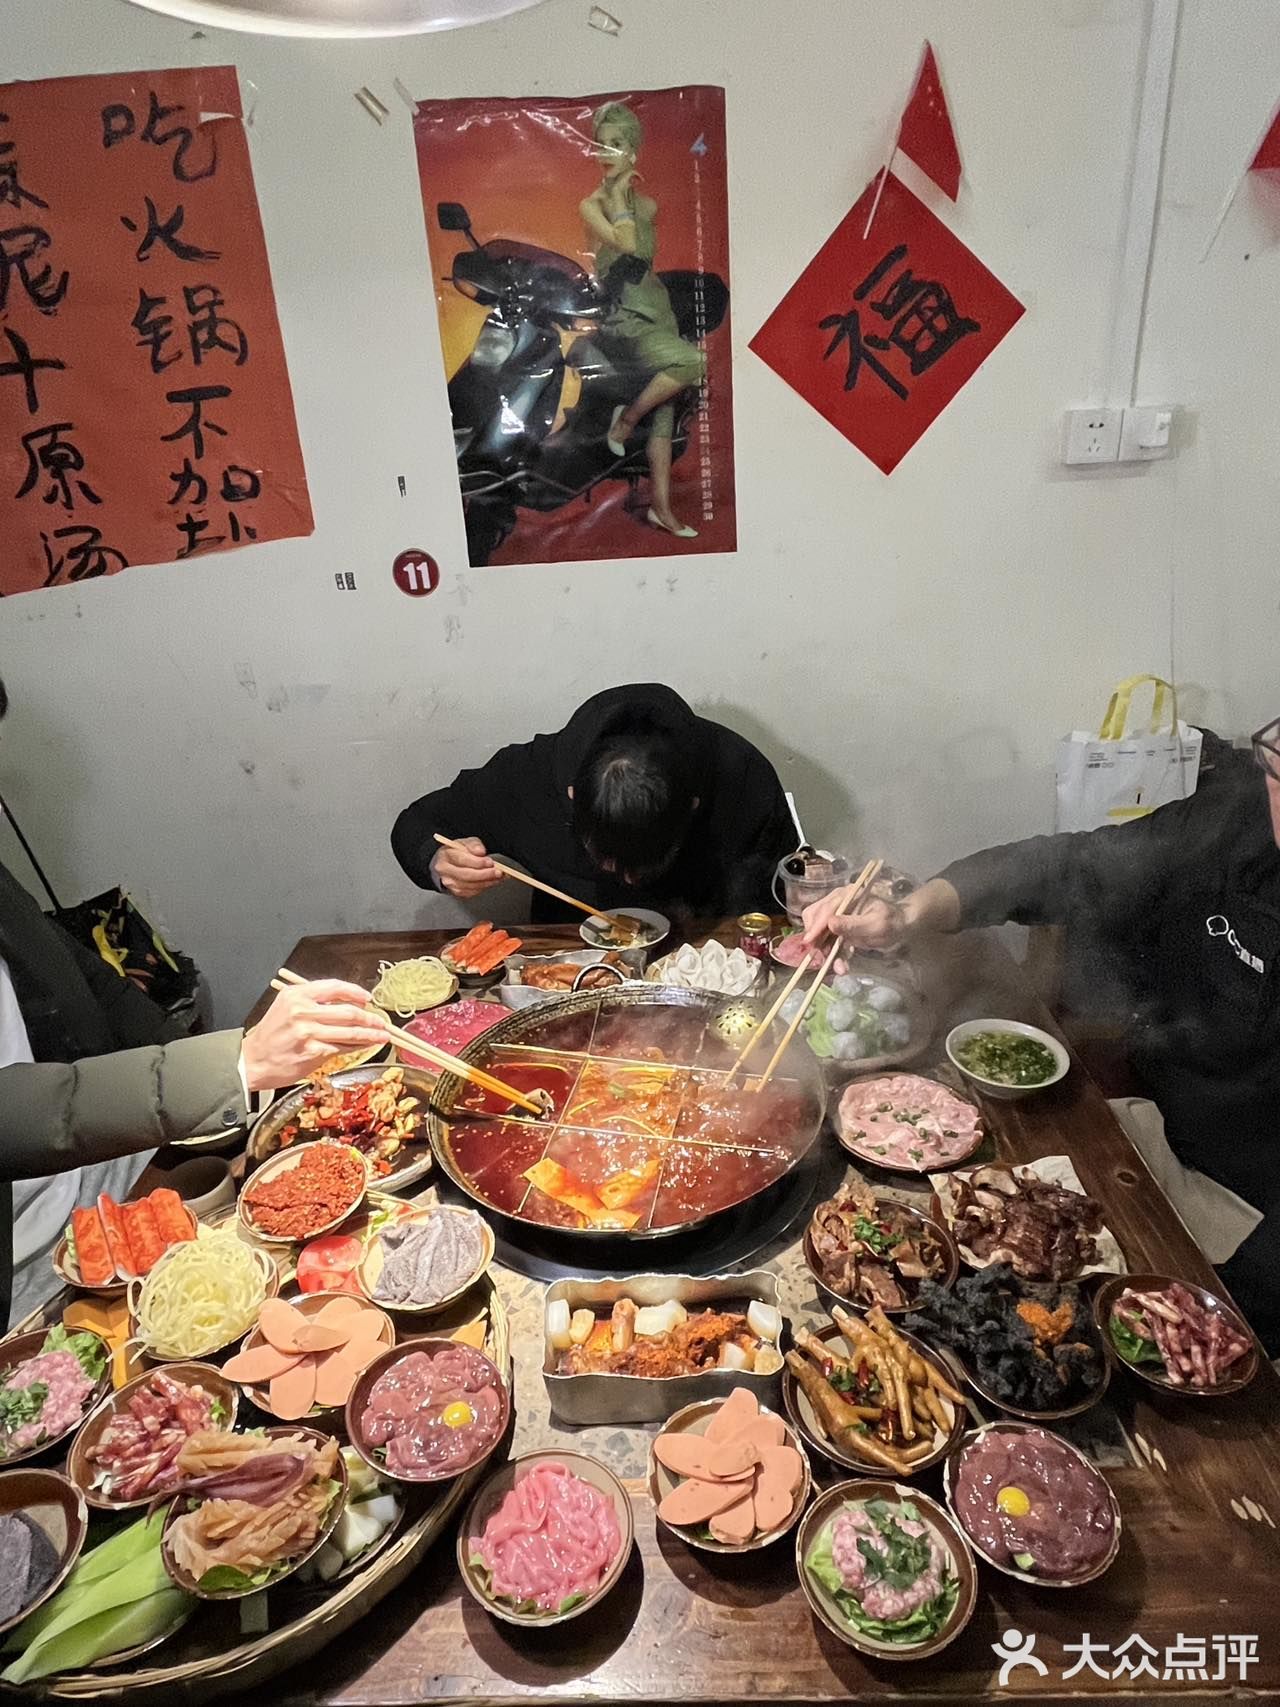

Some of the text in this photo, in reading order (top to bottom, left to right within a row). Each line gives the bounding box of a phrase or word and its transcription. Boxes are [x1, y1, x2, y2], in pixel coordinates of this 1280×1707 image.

[689, 132, 708, 156] 4
[818, 244, 981, 400] 福
[403, 562, 431, 590] 11
